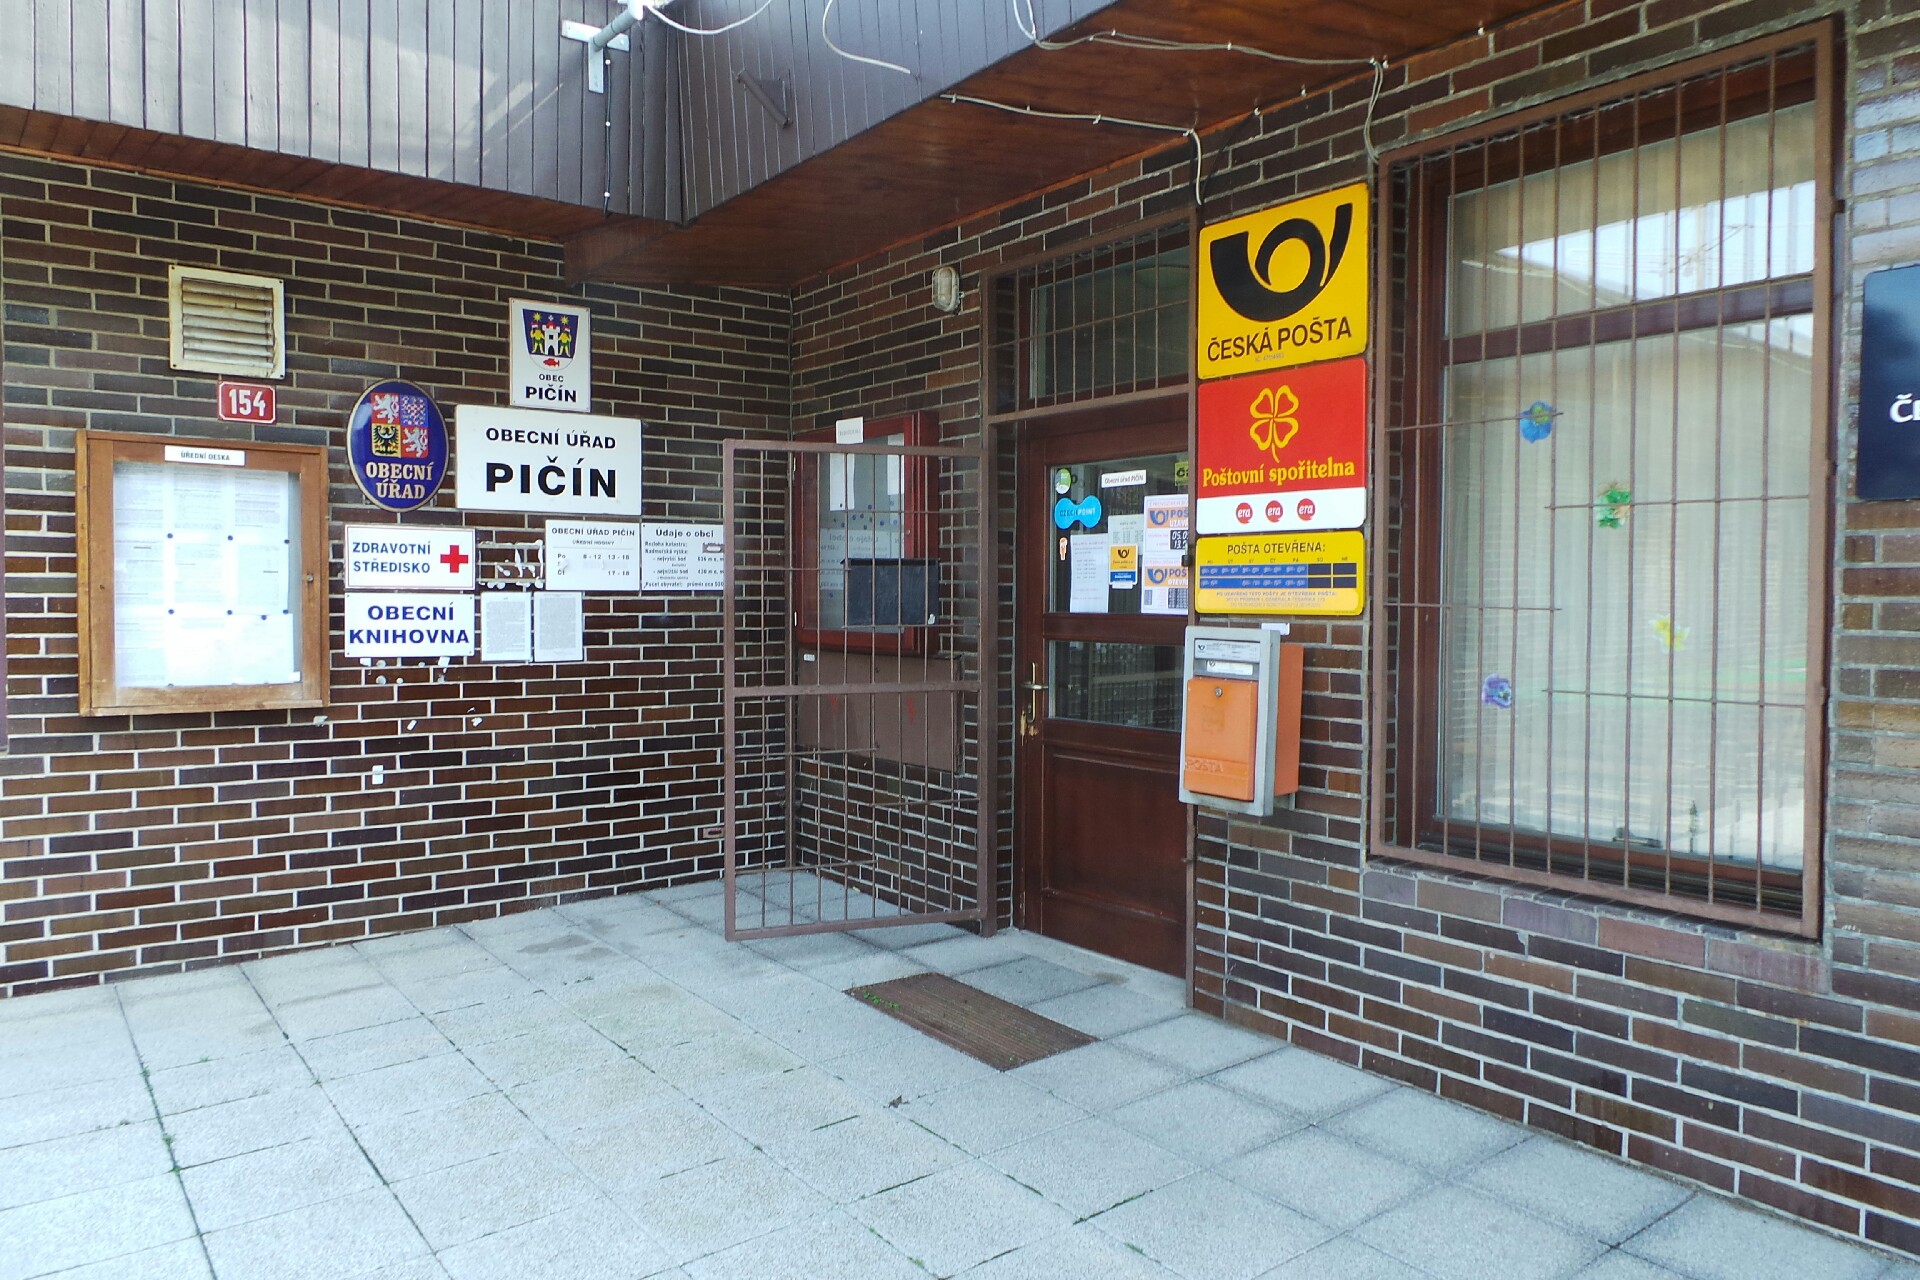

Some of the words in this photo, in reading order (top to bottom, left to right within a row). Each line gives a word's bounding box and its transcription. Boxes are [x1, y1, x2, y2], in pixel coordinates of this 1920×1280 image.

[1207, 327, 1273, 362] ČESKÁ
[1277, 316, 1352, 350] POŠTA
[538, 373, 564, 382] OBEC
[525, 384, 577, 403] PIČÍN
[229, 388, 266, 417] 154
[486, 428, 559, 446] OBECNÍ
[566, 429, 616, 449] ÚŘAD
[180, 450, 207, 460] ÚŘEDNÍ
[208, 453, 231, 461] DESKA
[366, 461, 433, 481] OBECNÍ
[486, 455, 616, 498] PIČÍN
[1202, 463, 1264, 487] Poštovní
[1268, 456, 1355, 486] spořitelna
[376, 479, 426, 499] ÚŘAD
[1237, 508, 1251, 518] era
[1267, 506, 1281, 516] era
[1299, 504, 1314, 514] era
[551, 527, 584, 535] OBECNÍ
[612, 528, 635, 537] PIČÍN
[655, 527, 683, 538] Údaje
[694, 530, 714, 538] obci
[1171, 531, 1188, 540] 05.0
[352, 541, 431, 555] ZDRAVOTNÍ
[1227, 541, 1260, 554] POŠTA
[1263, 539, 1326, 554] OTEVŘENA:
[353, 558, 431, 573] STŘEDISKO
[367, 601, 454, 621] OBECNÍ
[349, 629, 470, 644] KNIHOVNA
